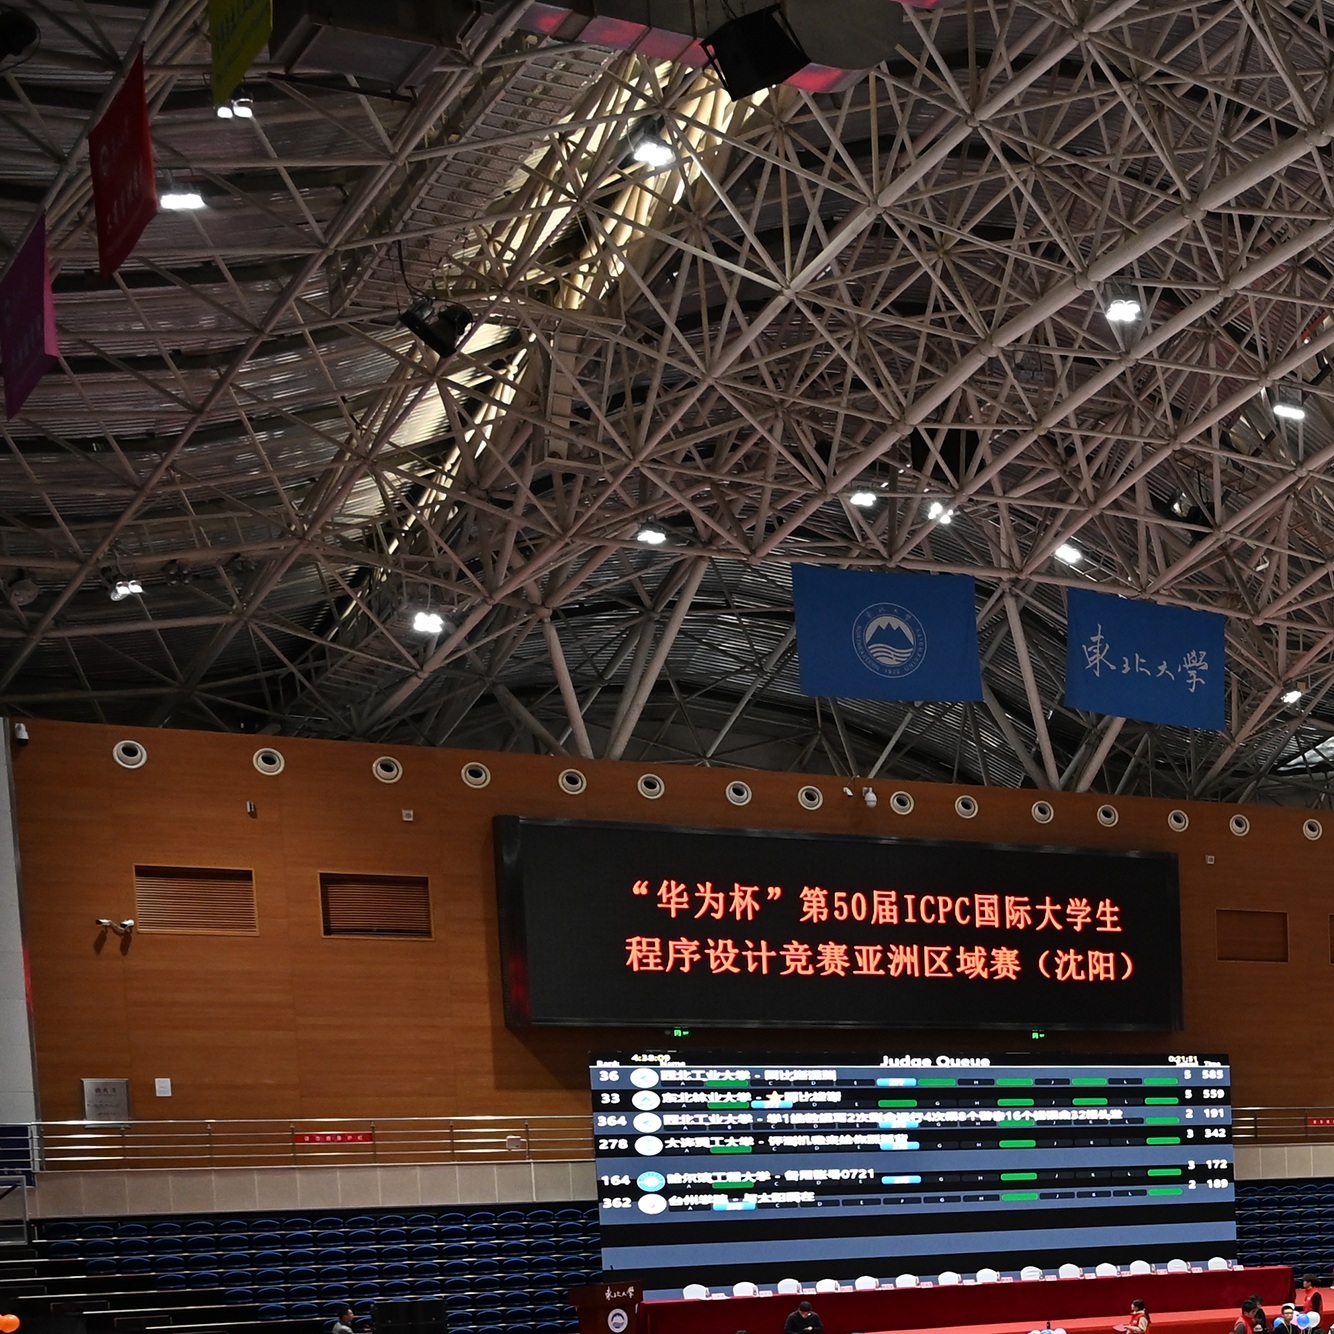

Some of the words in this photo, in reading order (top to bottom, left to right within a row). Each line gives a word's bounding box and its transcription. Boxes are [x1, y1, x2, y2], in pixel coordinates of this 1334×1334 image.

[880, 1055, 931, 1067] Judge
[936, 1056, 990, 1067] Queue
[599, 1070, 619, 1082] 36
[1184, 1070, 1192, 1080] 5
[1202, 1070, 1224, 1080] 585
[600, 1093, 620, 1104] 33
[1185, 1089, 1193, 1099] 5
[1203, 1089, 1225, 1099] 559
[598, 1115, 628, 1127] 364
[1185, 1109, 1193, 1119] 2
[1203, 1109, 1225, 1119] 191
[599, 1138, 629, 1150] 278
[1187, 1129, 1194, 1139] 3
[1204, 1129, 1226, 1138] 342
[601, 1174, 631, 1186] 164
[1188, 1160, 1195, 1170] 3
[1206, 1160, 1228, 1169] 172
[602, 1196, 632, 1209] 362
[1188, 1180, 1197, 1189] 2
[1207, 1179, 1229, 1189] 189
